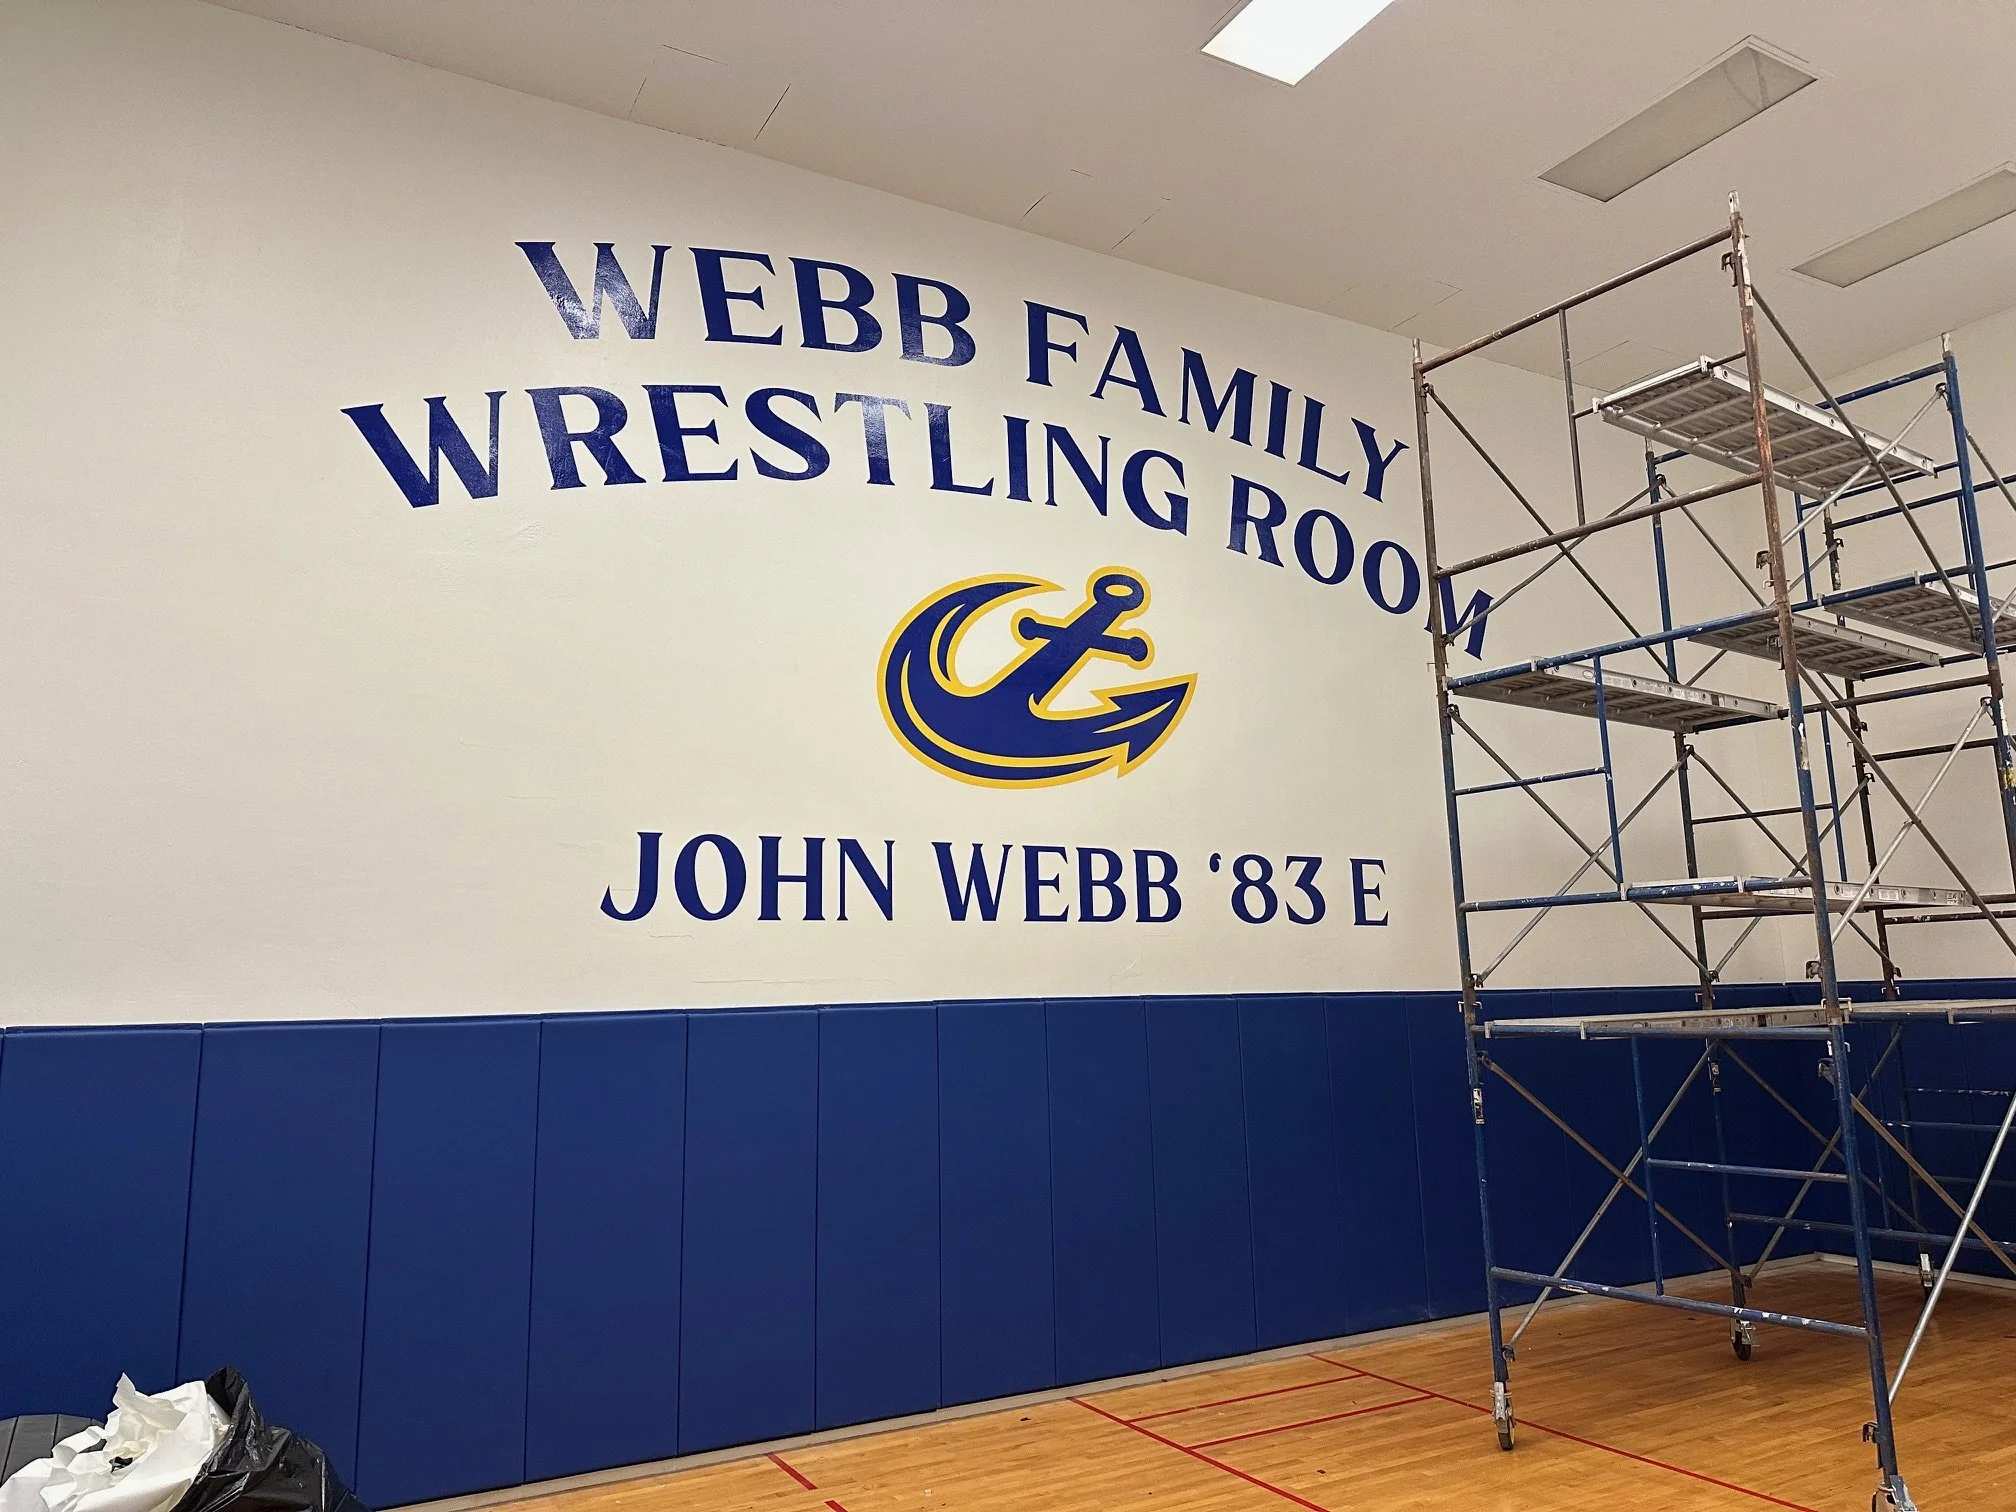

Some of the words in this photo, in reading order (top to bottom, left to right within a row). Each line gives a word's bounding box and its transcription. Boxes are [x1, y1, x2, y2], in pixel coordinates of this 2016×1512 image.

[515, 241, 977, 367] WEBB
[1024, 300, 1411, 503] FAMILY
[341, 382, 1189, 537] WRESTLING
[1227, 475, 1495, 662] ROOM
[600, 831, 895, 922] JOHN
[931, 841, 1182, 925] WEBB
[1351, 858, 1390, 927] E
